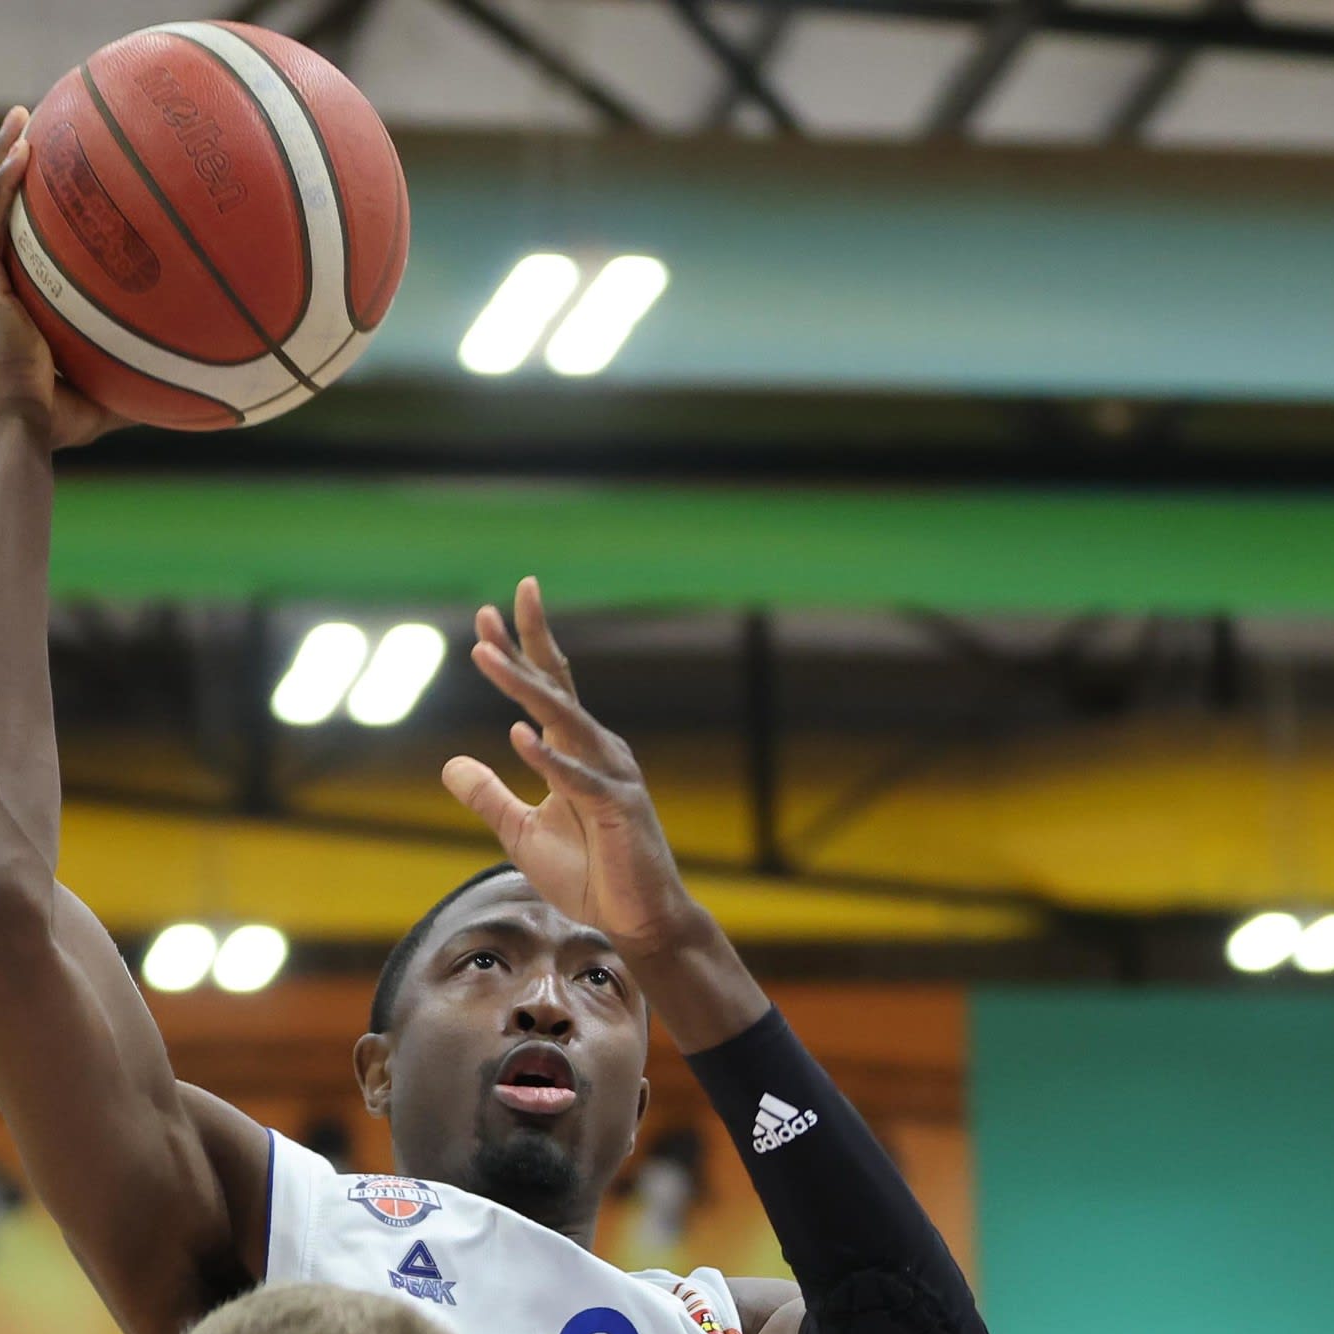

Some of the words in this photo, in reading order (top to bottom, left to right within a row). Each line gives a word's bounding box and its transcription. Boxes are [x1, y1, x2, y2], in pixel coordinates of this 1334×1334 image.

[133, 68, 249, 214] molten
[753, 1109, 818, 1154] adidas
[387, 1269, 457, 1306] PEAK
